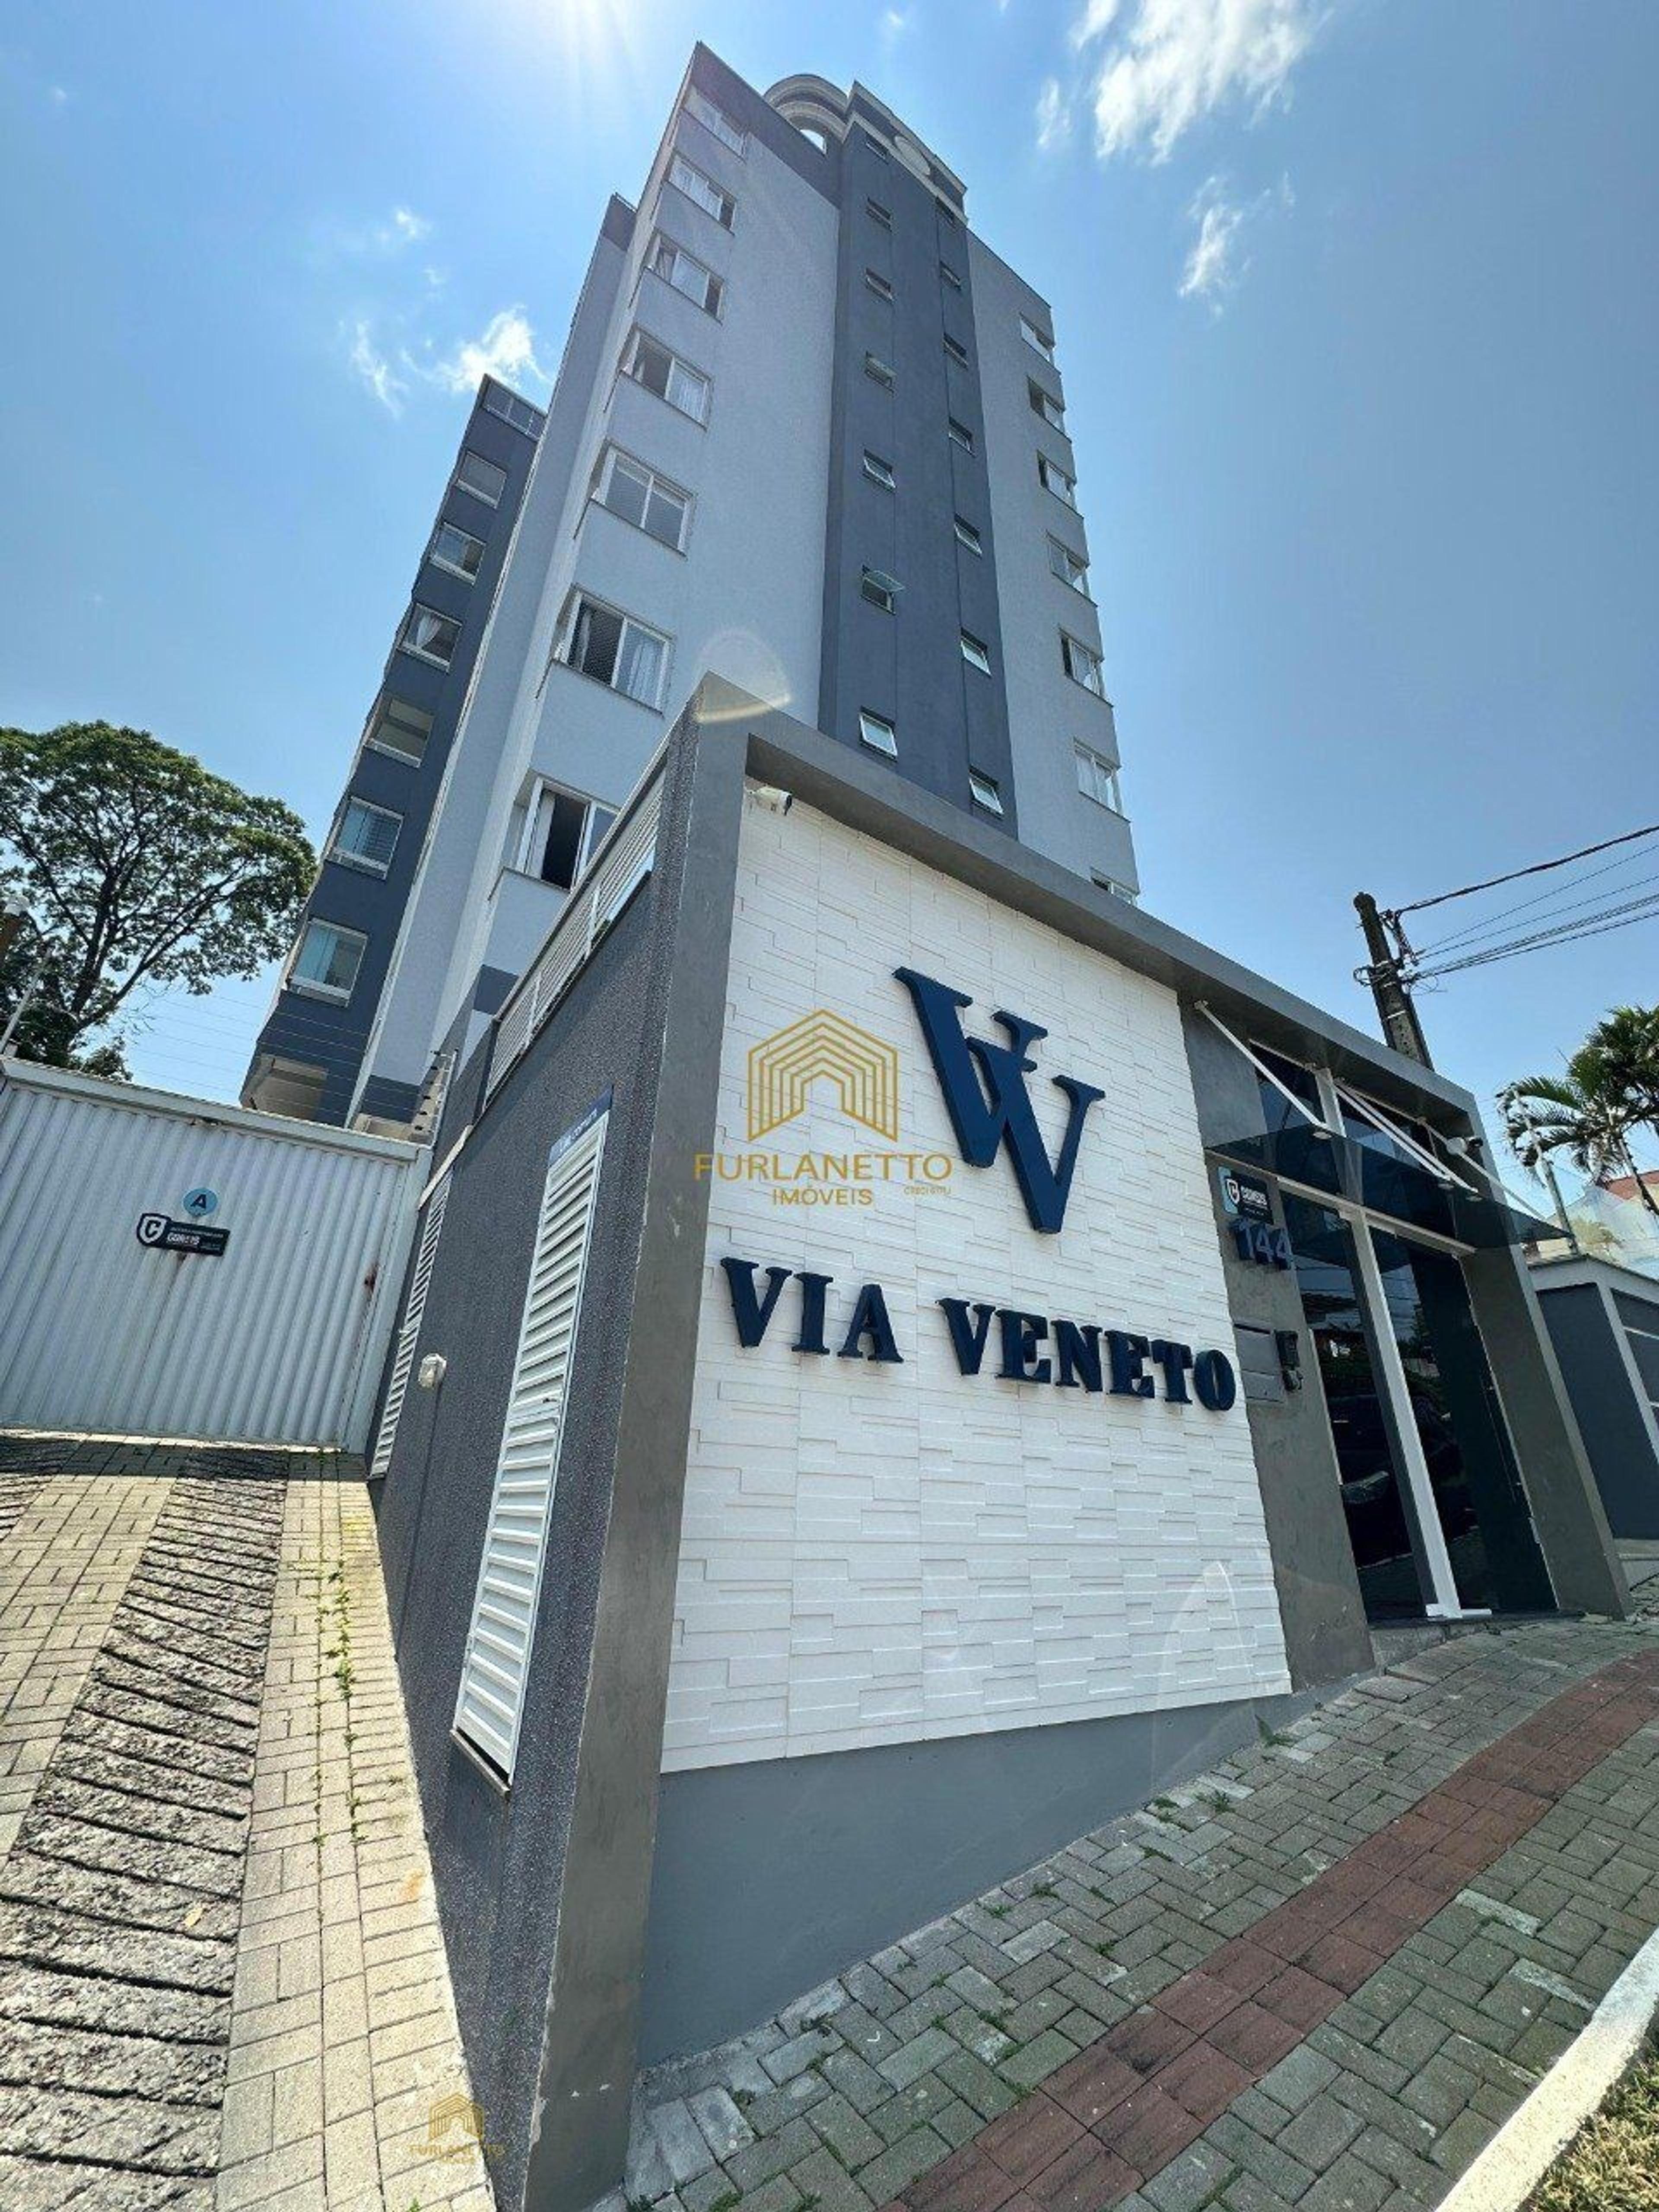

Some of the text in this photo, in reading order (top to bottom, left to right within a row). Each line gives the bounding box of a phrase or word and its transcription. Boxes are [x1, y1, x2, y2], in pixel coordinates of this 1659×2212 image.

[190, 1194, 207, 1208] A
[1231, 1217, 1293, 1270] 144
[720, 1256, 1237, 1411] VIA VENETO
